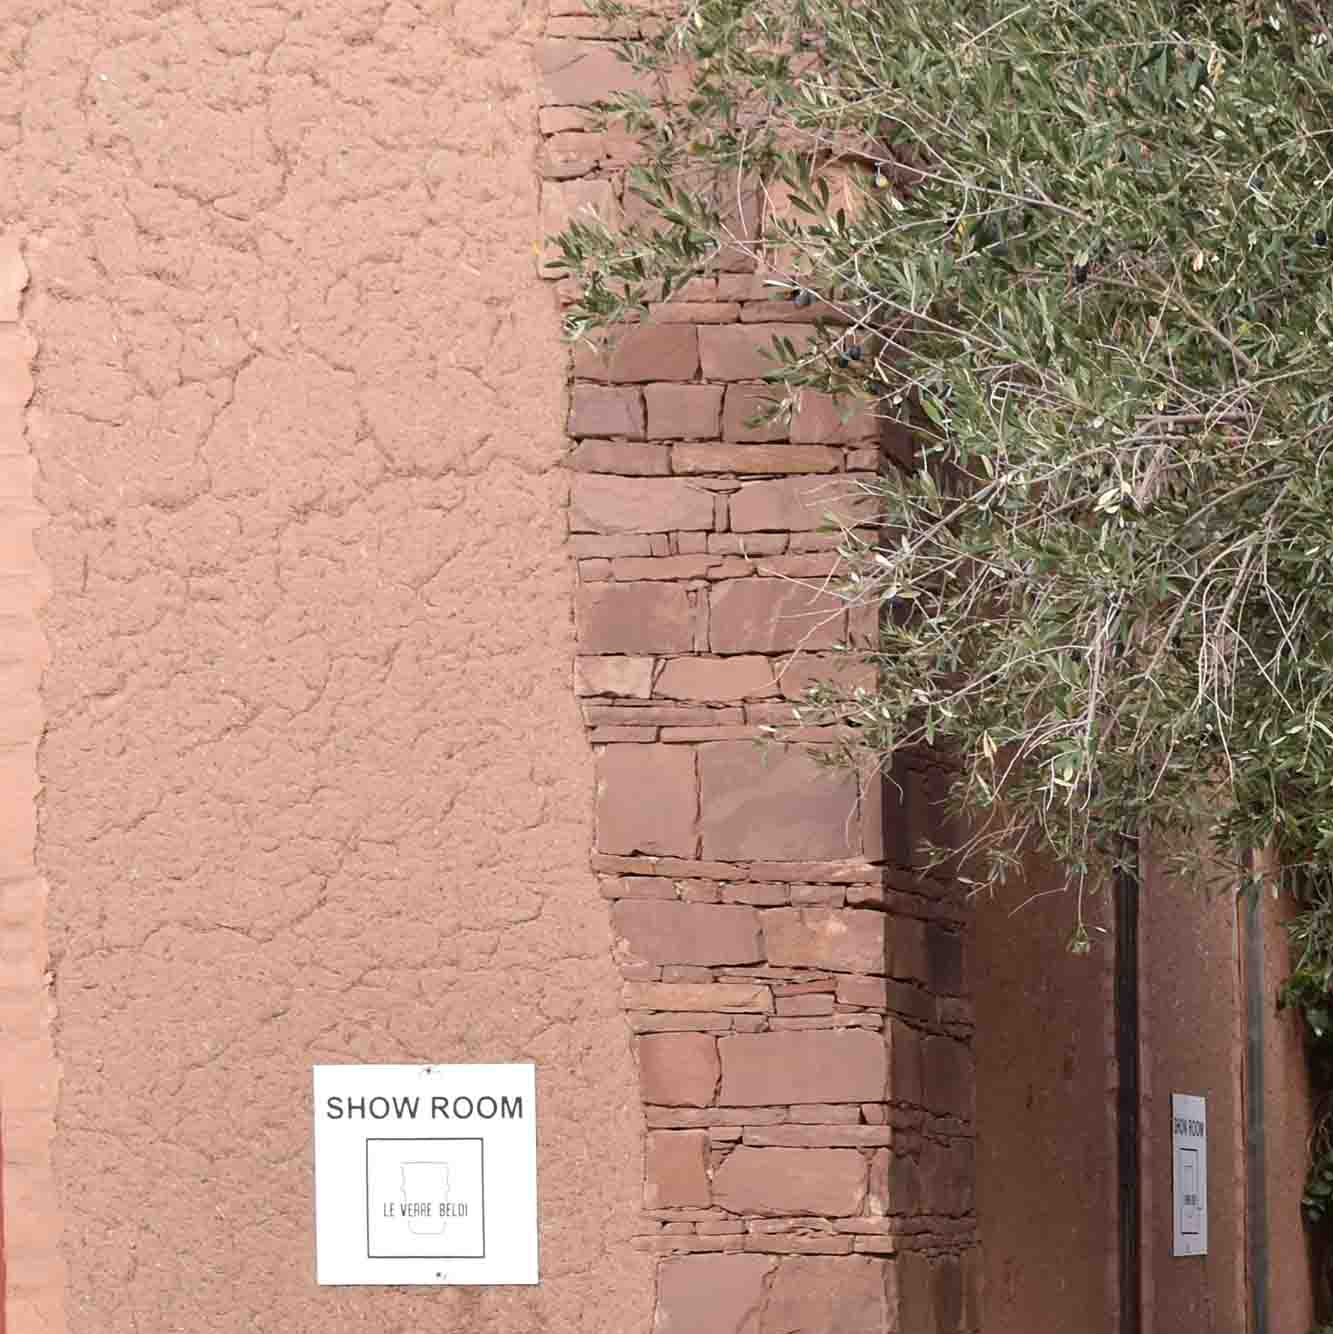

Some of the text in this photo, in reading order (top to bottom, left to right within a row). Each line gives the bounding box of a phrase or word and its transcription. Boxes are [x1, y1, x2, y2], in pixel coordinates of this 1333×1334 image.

[326, 1095, 524, 1120] SHOW ROOM
[1188, 1120, 1204, 1138] ROOM
[383, 1202, 469, 1218] LE VERRE BELDI
